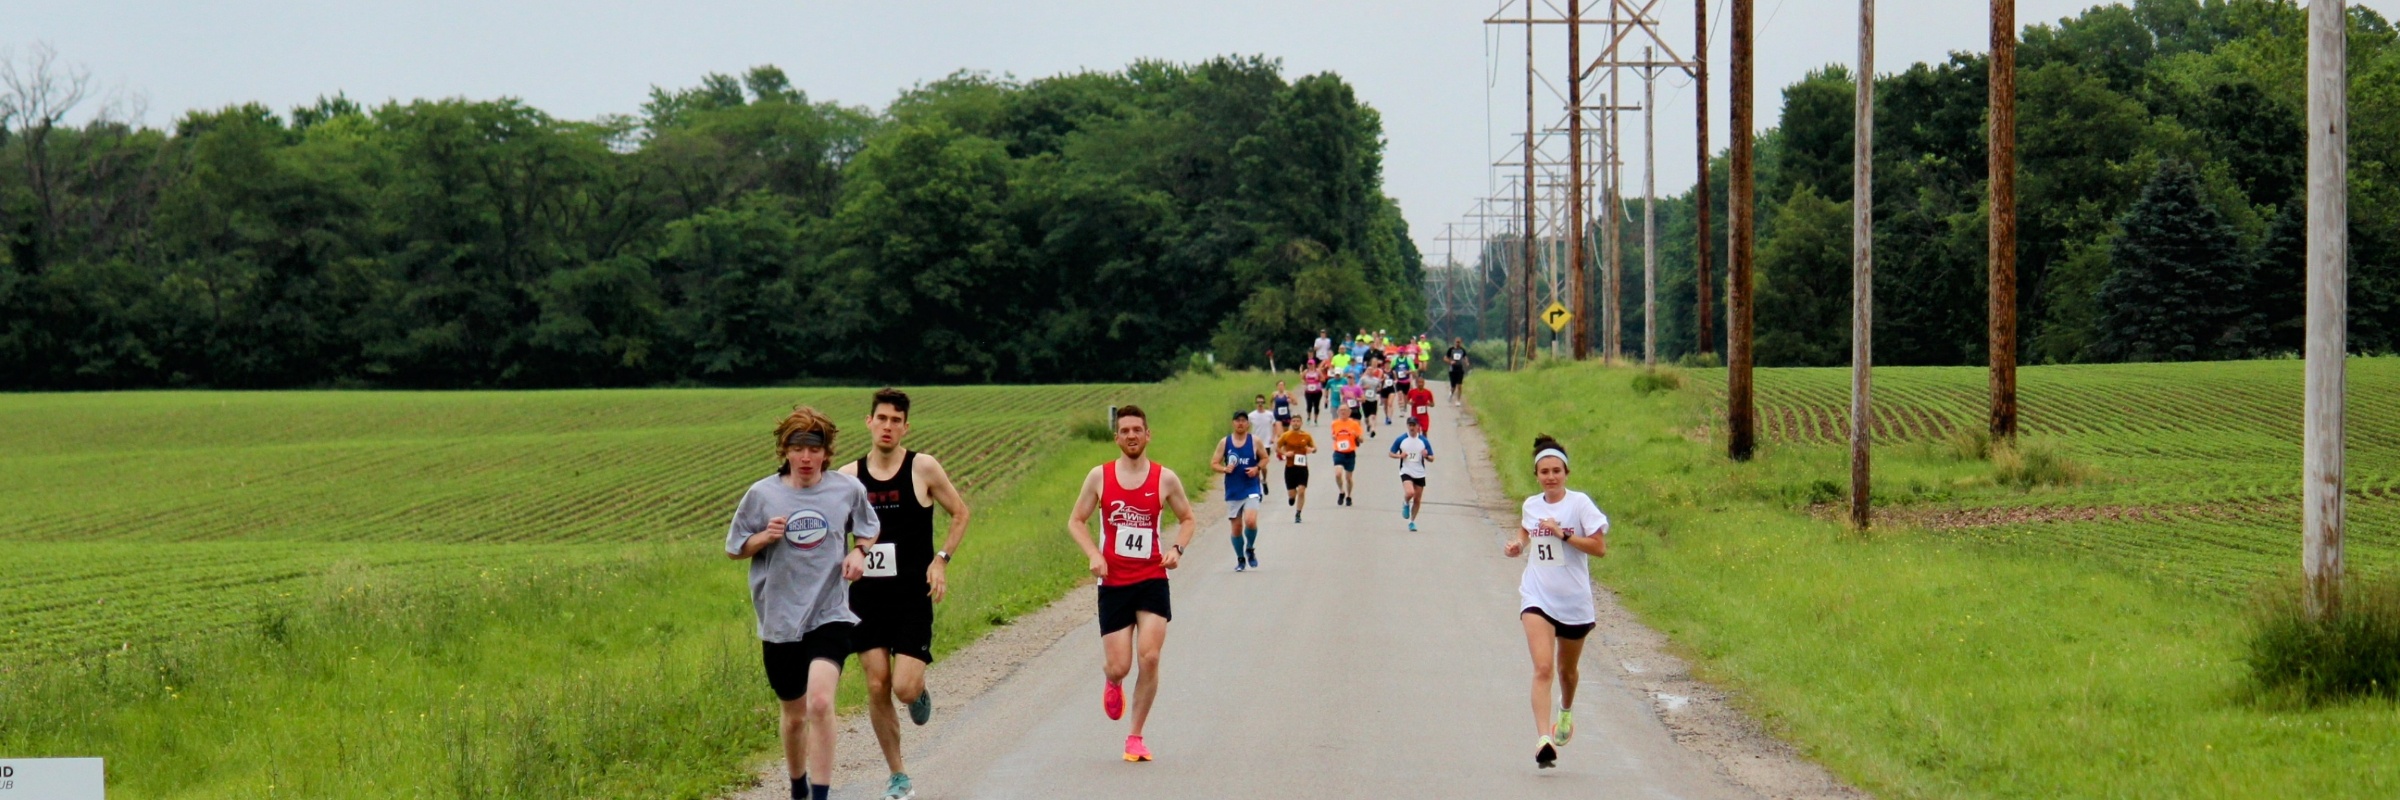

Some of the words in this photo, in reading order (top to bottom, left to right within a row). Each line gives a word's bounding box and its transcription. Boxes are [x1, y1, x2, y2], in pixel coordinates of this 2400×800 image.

[789, 518, 823, 531] BASKETBALL
[1125, 534, 1143, 551] 44
[1538, 544, 1554, 560] 51
[868, 551, 885, 570] 32
